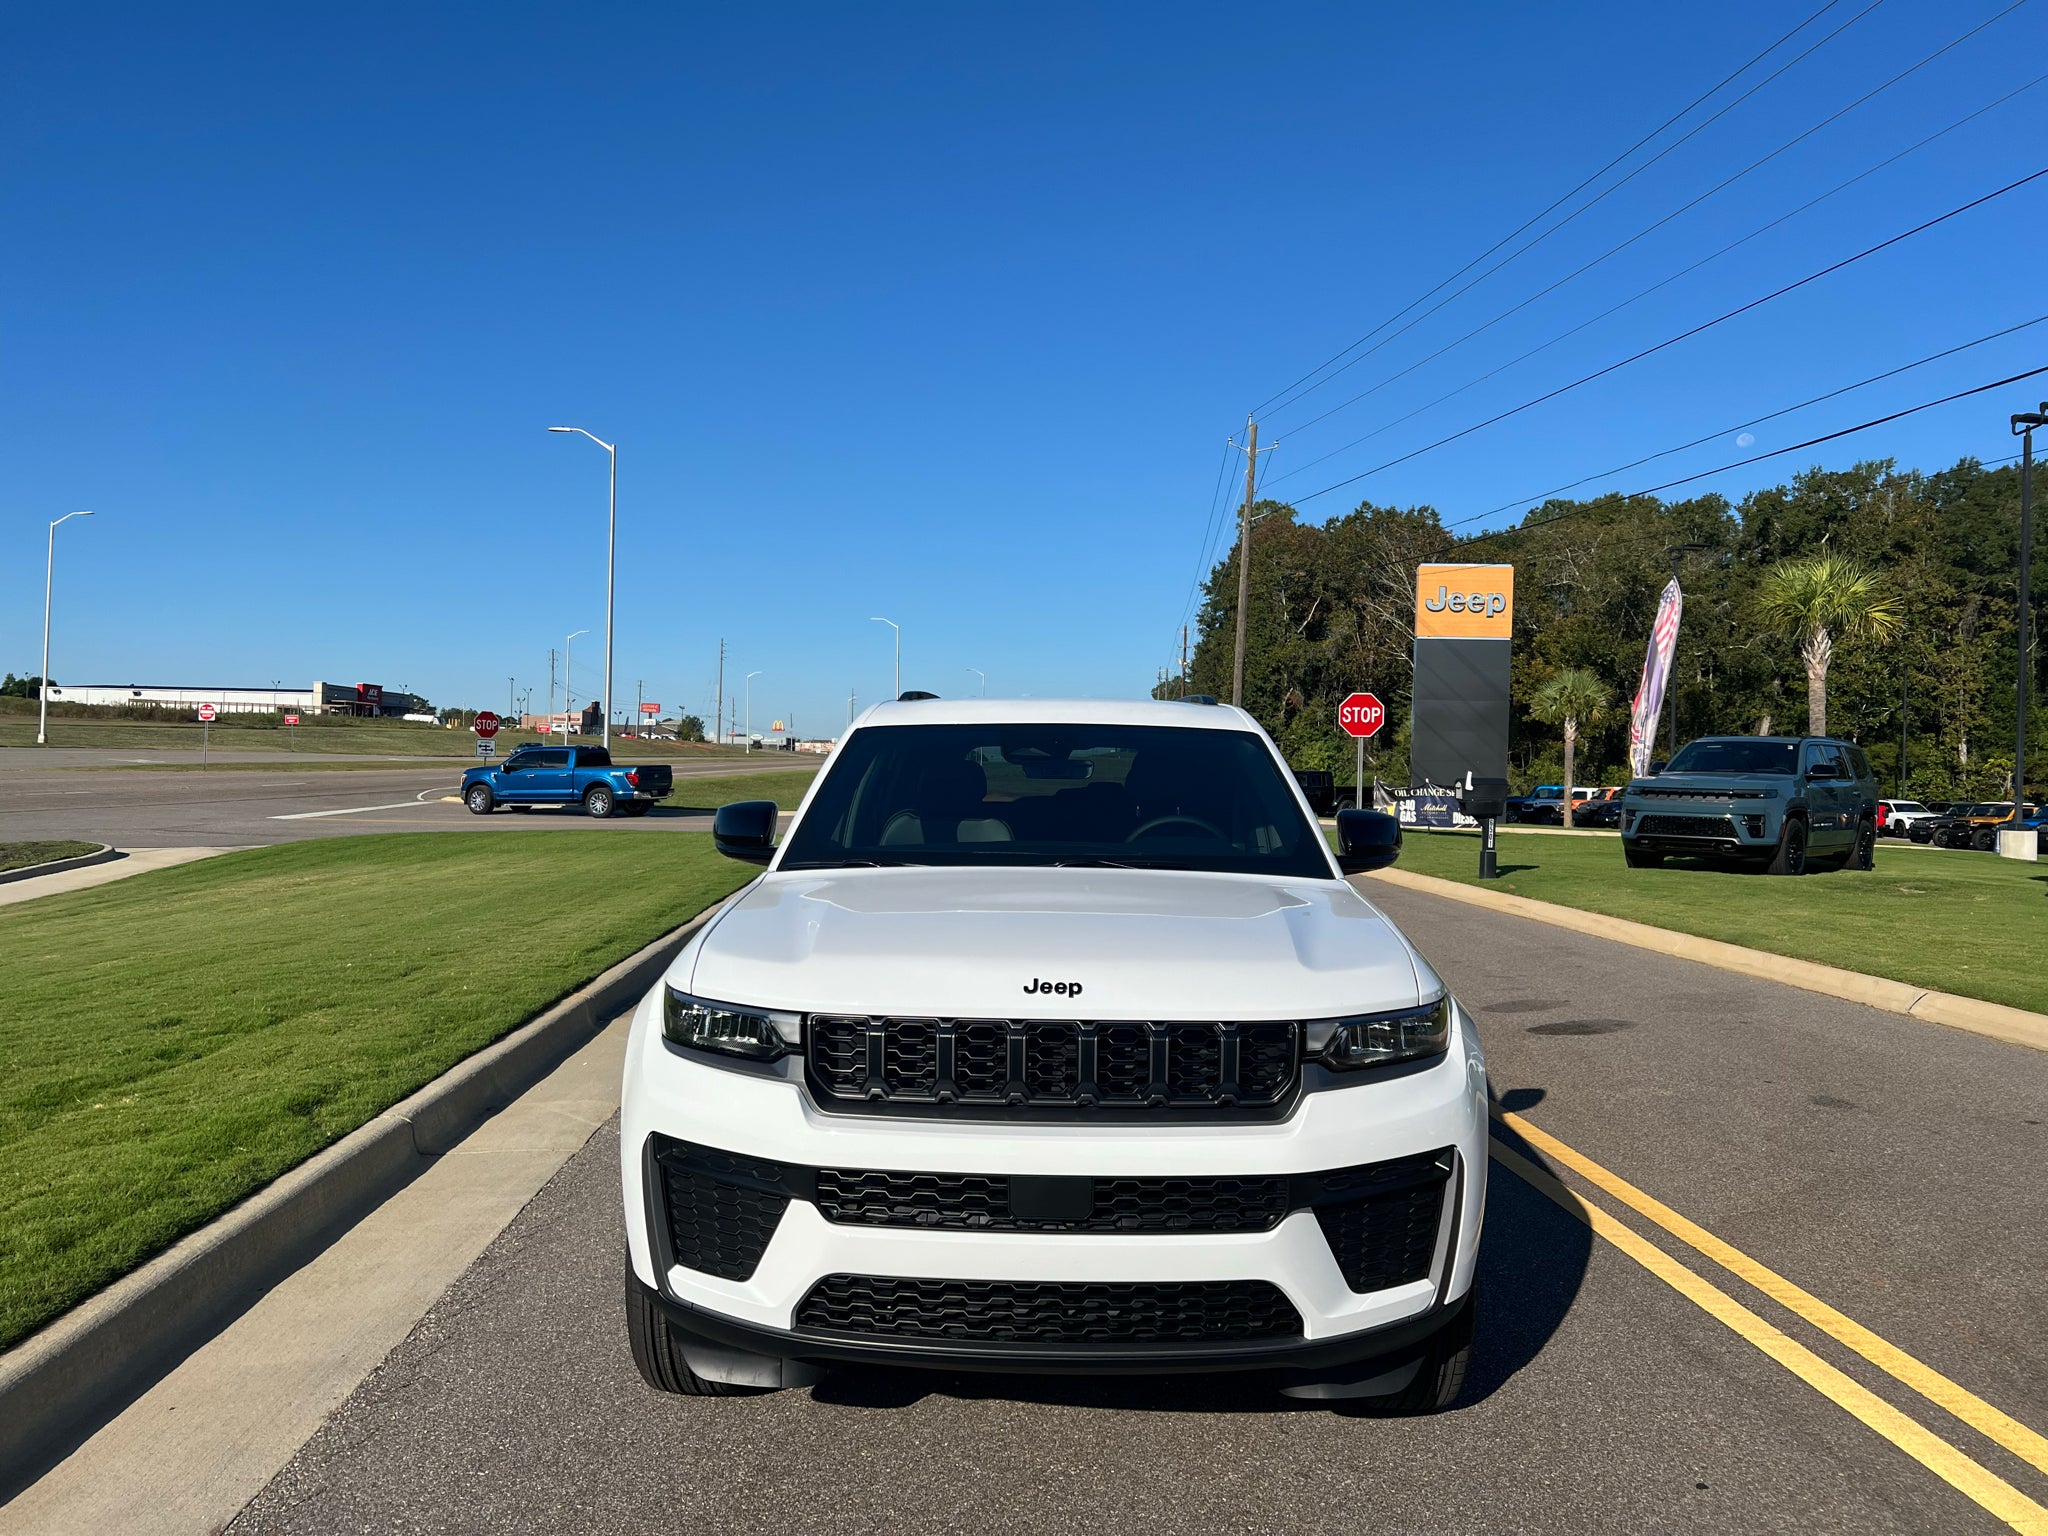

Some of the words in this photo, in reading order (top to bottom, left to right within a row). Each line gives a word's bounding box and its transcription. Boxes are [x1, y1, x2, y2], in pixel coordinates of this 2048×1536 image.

[1425, 586, 1506, 618] Jeep
[1342, 707, 1381, 723] STOP
[476, 719, 498, 730] STOP
[1410, 788, 1445, 797] CHANGE
[1400, 810, 1417, 823] GAS
[1453, 811, 1478, 824] Diese
[1023, 978, 1083, 998] Jeep
